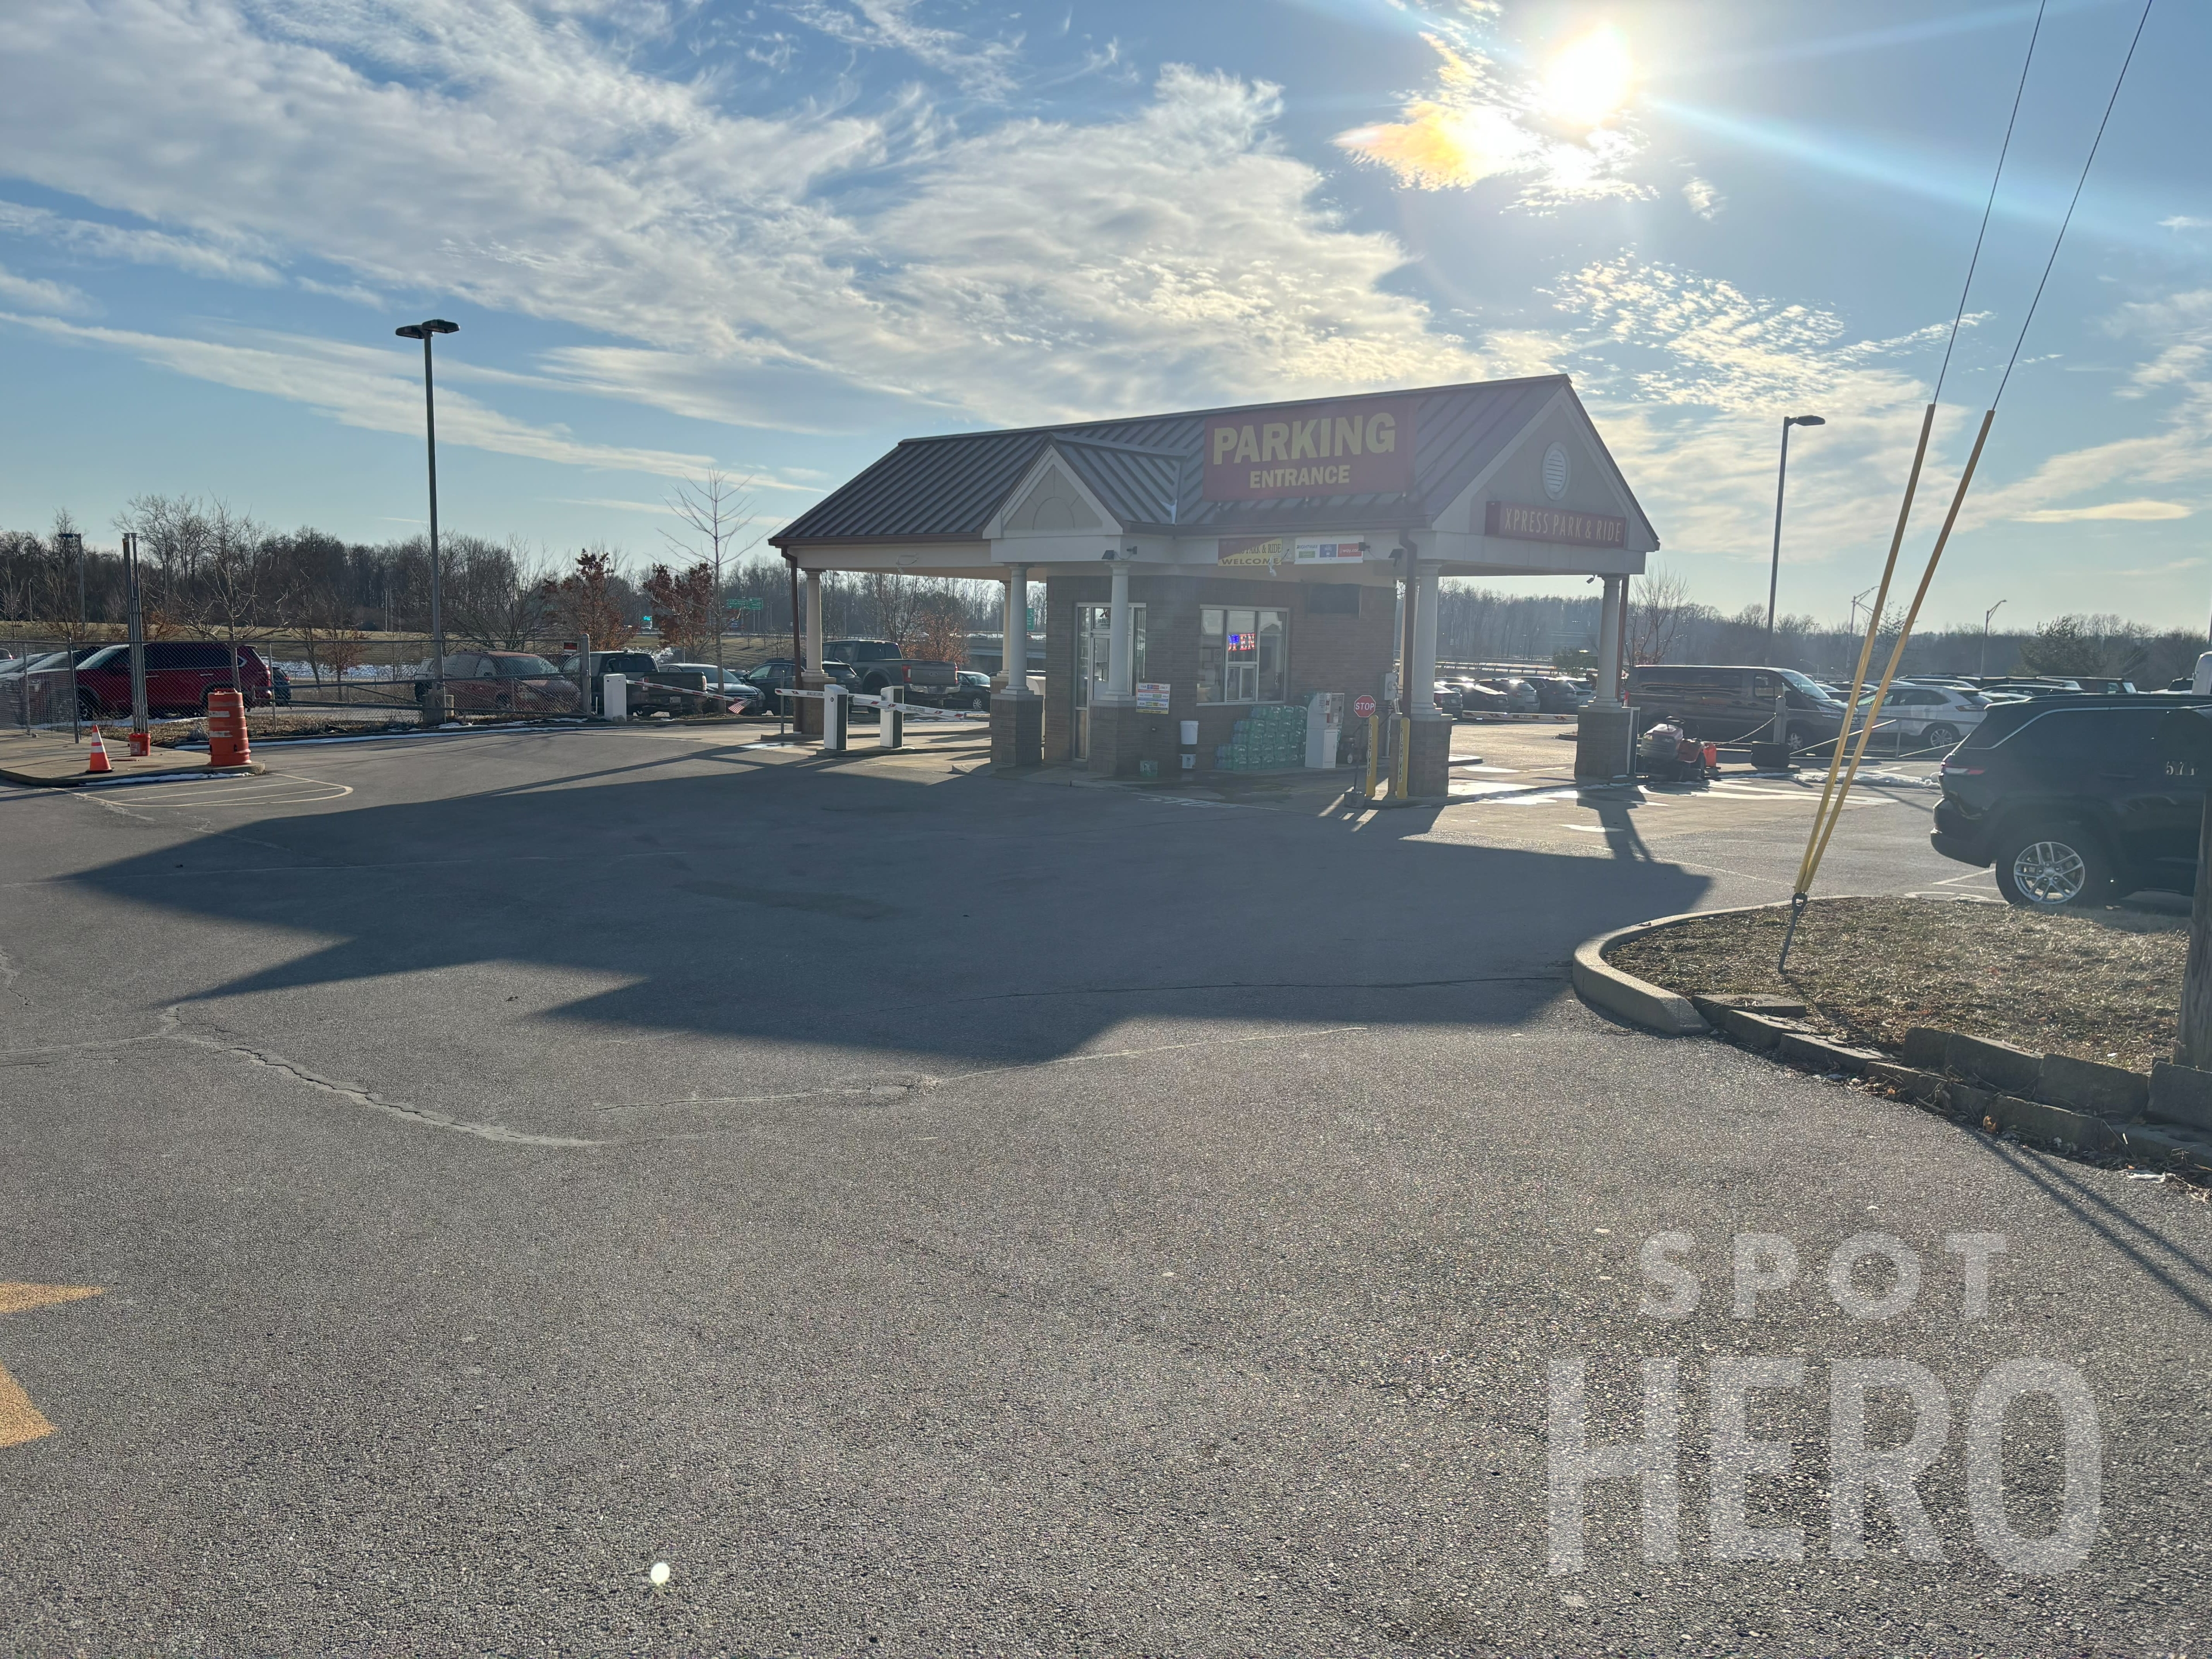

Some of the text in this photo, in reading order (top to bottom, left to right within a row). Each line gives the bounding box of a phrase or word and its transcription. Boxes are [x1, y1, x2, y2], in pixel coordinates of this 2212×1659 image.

[1213, 412, 1396, 465] PARKING
[1249, 465, 1350, 488] ENTRANCE
[1505, 508, 1621, 542] XPRESS PARK & RIDE
[1268, 544, 1281, 554] RIDE
[1355, 702, 1375, 711] STOP
